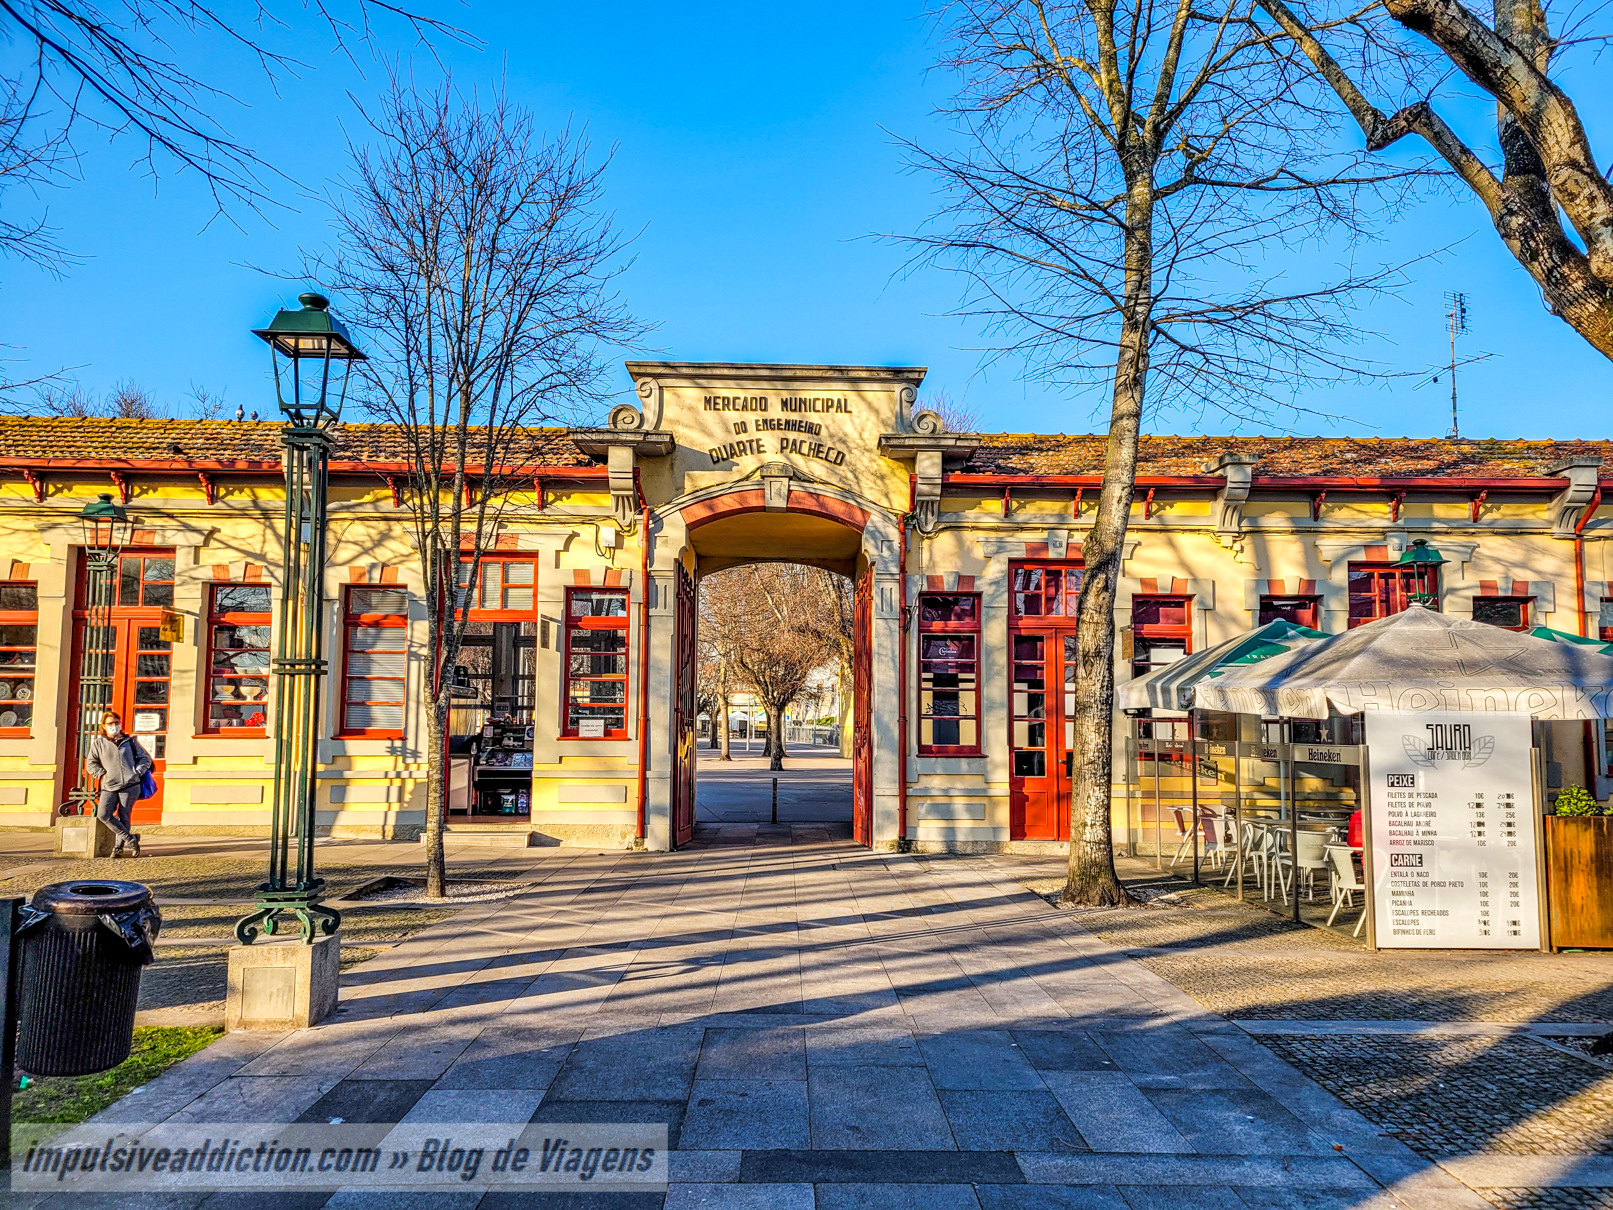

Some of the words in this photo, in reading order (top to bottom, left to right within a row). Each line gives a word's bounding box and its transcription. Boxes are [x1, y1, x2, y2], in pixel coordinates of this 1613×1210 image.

[703, 396, 769, 412] MERCADO
[780, 397, 853, 413] MUNICIPAL
[733, 420, 749, 435] DO
[754, 418, 823, 436] ENGENHEIRO
[708, 438, 767, 465] DUARTE
[780, 437, 846, 467] PACHECO
[1337, 681, 1613, 719] Heinek
[1425, 723, 1472, 751] SAURA
[1308, 748, 1342, 763] Heineken
[1388, 775, 1414, 787] PEIXE
[1475, 792, 1485, 800] 10€
[1475, 811, 1486, 819] 13€
[1505, 811, 1516, 819] 25€
[1406, 839, 1412, 847] DE
[1413, 839, 1435, 847] MARISCO
[1391, 854, 1422, 867] CARNE
[1478, 871, 1488, 879] 10€
[1508, 871, 1519, 879] 20€
[1390, 880, 1421, 888] COSTELETAS
[1422, 880, 1429, 888] DE
[1430, 880, 1447, 888] PORCO
[1448, 880, 1465, 888] PRETO
[1508, 881, 1519, 889] 20€
[1509, 890, 1520, 898] 20€
[1421, 909, 1450, 917] RECHEADOS
[1416, 928, 1422, 936] DE
